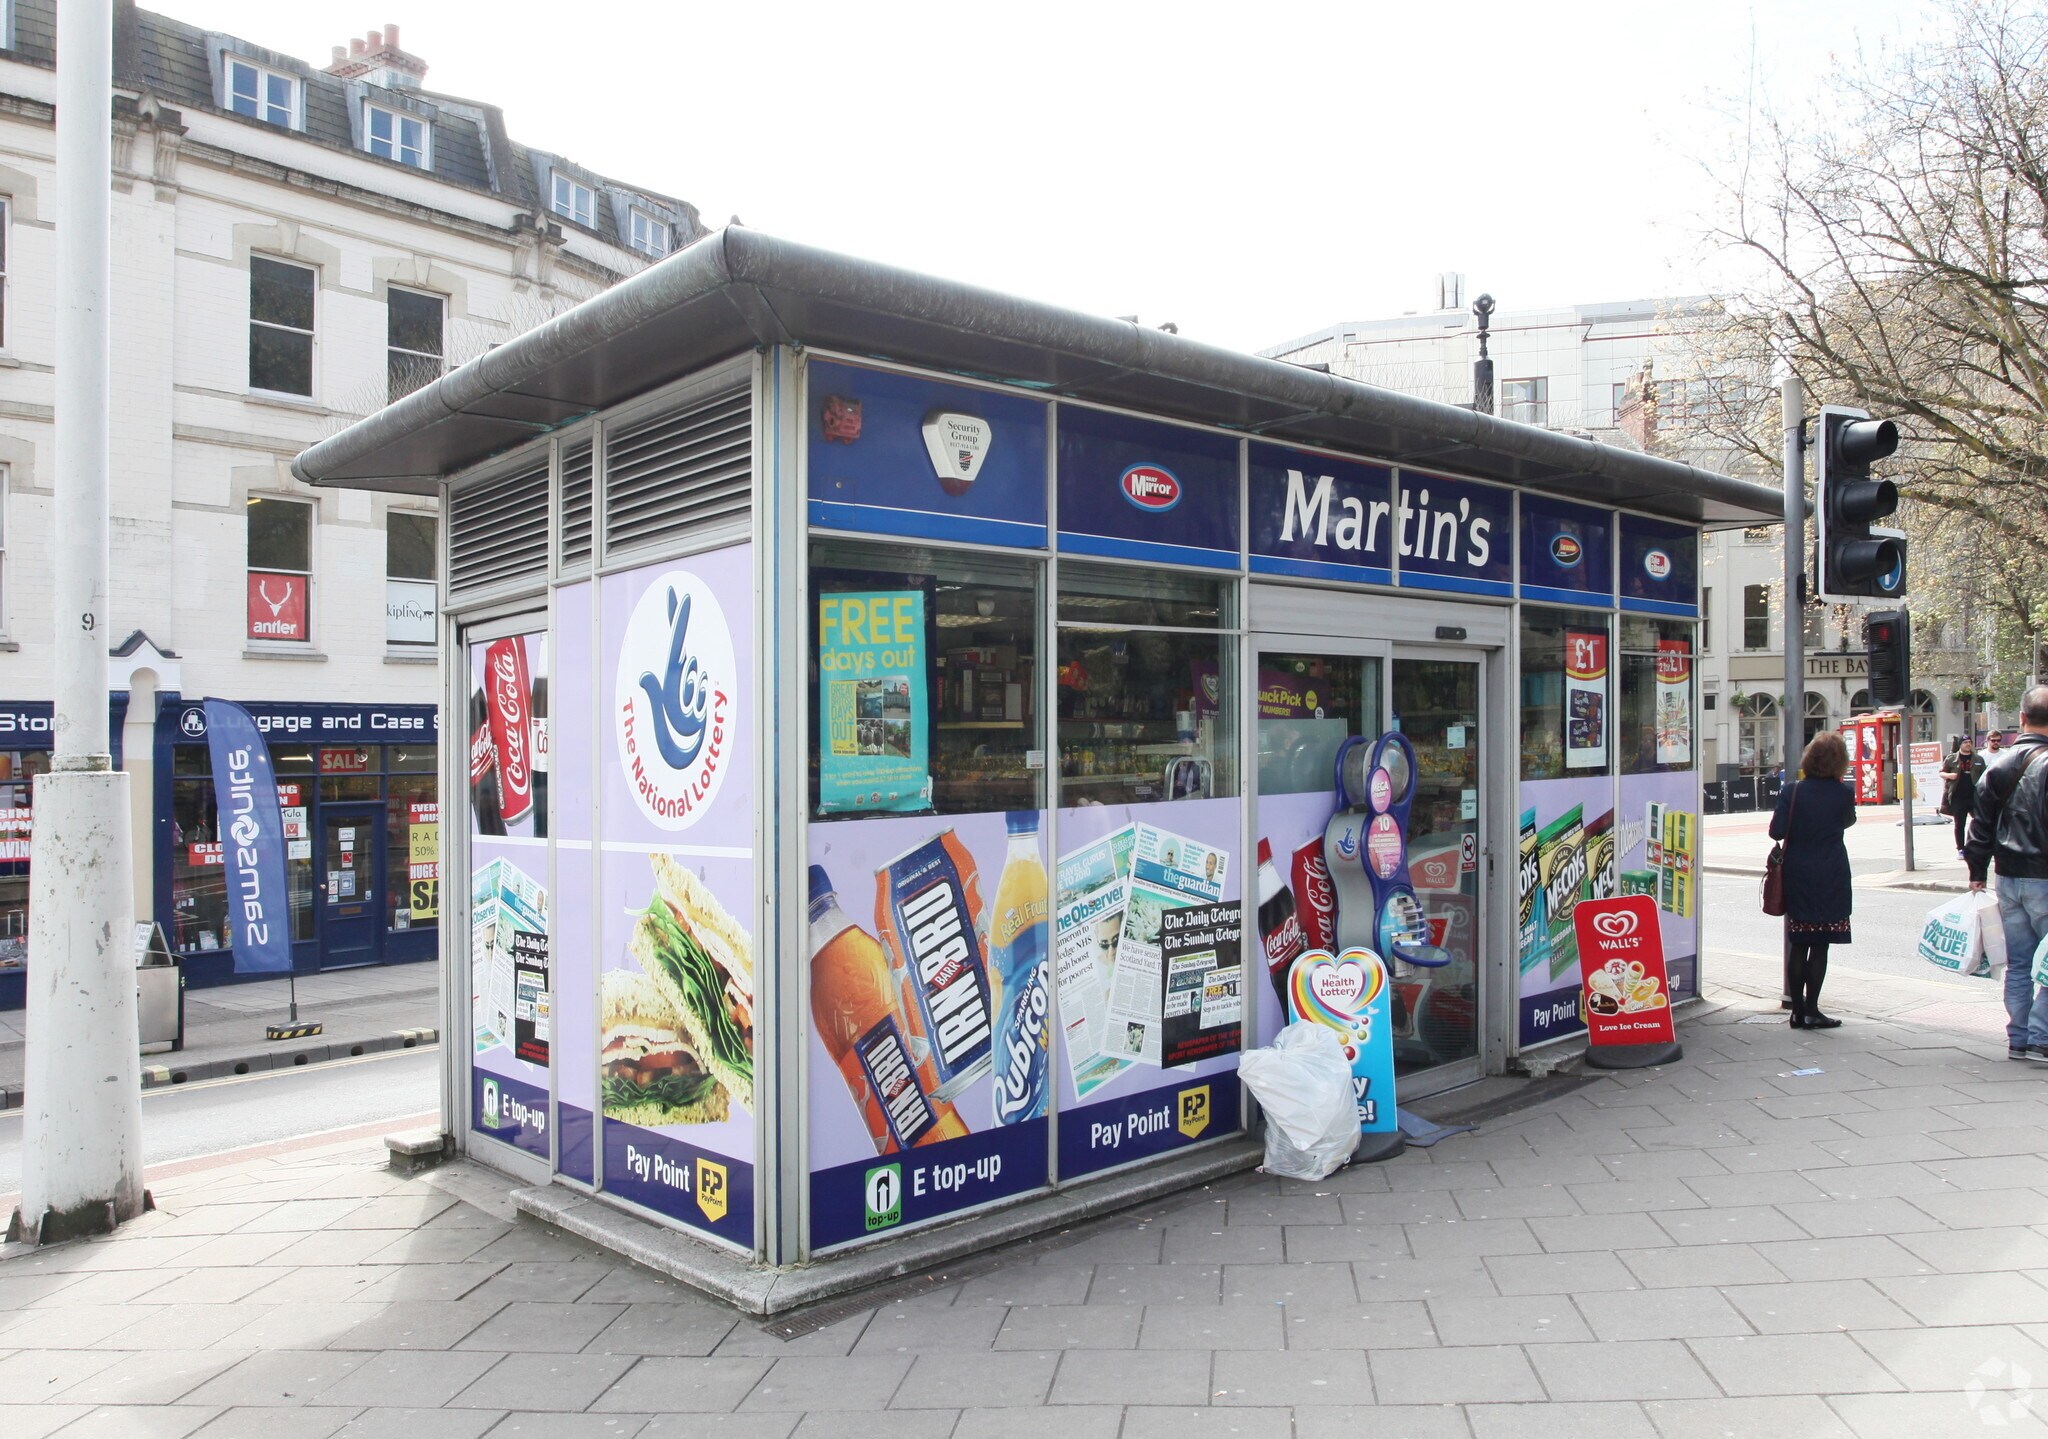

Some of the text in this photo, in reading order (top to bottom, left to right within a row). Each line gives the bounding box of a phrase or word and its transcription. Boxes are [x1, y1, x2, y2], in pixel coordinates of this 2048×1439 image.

[947, 420, 981, 436] Security
[951, 431, 978, 445] Group
[1131, 474, 1172, 497] Mirror
[1280, 469, 1491, 567] Martin's
[386, 603, 424, 621] kipling
[82, 612, 95, 632] 9
[253, 619, 297, 635] antler
[819, 597, 915, 647] FREE
[821, 645, 915, 674] days out
[1575, 638, 1594, 669] £1
[1807, 658, 1839, 674] THE
[1258, 690, 1301, 707] uick Pick
[322, 713, 362, 729] and
[370, 713, 425, 729] Case
[494, 647, 529, 796] Coca-Cola
[832, 721, 854, 740] OUT
[322, 754, 364, 769] SALE
[623, 690, 728, 818] The National Lottery
[1379, 816, 1390, 832] 10
[928, 858, 942, 870] BEST
[1558, 849, 1569, 860] REAL
[410, 864, 434, 879] HUGE
[1075, 867, 1091, 882] 2010
[412, 880, 439, 911] SA
[1071, 886, 1124, 922] Observer
[1303, 854, 1336, 955] oca-Cola
[1000, 907, 1025, 942] Real
[1164, 908, 1241, 930] The Daily Telegr
[1524, 920, 1538, 935] MALT
[901, 882, 970, 985] BRU
[1057, 929, 1082, 947] ameron
[1164, 928, 1241, 950] The Sunday Telegr
[1266, 912, 1301, 959] Coca-Cola
[1929, 919, 1968, 942] AMAZING
[1076, 936, 1093, 951] NHS
[1122, 943, 1131, 951] We
[1520, 933, 1534, 949] EGAR
[1599, 938, 1639, 950] WALL'S
[1923, 925, 1967, 957] VALUE!
[1071, 951, 1090, 968] boost
[934, 961, 961, 987] BARR
[1069, 962, 1094, 984] poorest
[1322, 978, 1355, 987] Health
[1667, 974, 1680, 990] -up
[1014, 966, 1037, 1030] SPARKLING
[1205, 984, 1223, 998] FREE
[1320, 987, 1357, 997] Lottery
[1533, 1000, 1575, 1028] Pay Point
[1633, 1022, 1661, 1030] Cream
[503, 1093, 545, 1134] E top-up
[1091, 1105, 1170, 1149] Pay Point
[627, 1144, 690, 1192] Pay Point
[913, 1154, 1001, 1197] E top-up
[867, 1210, 900, 1226] top-up
